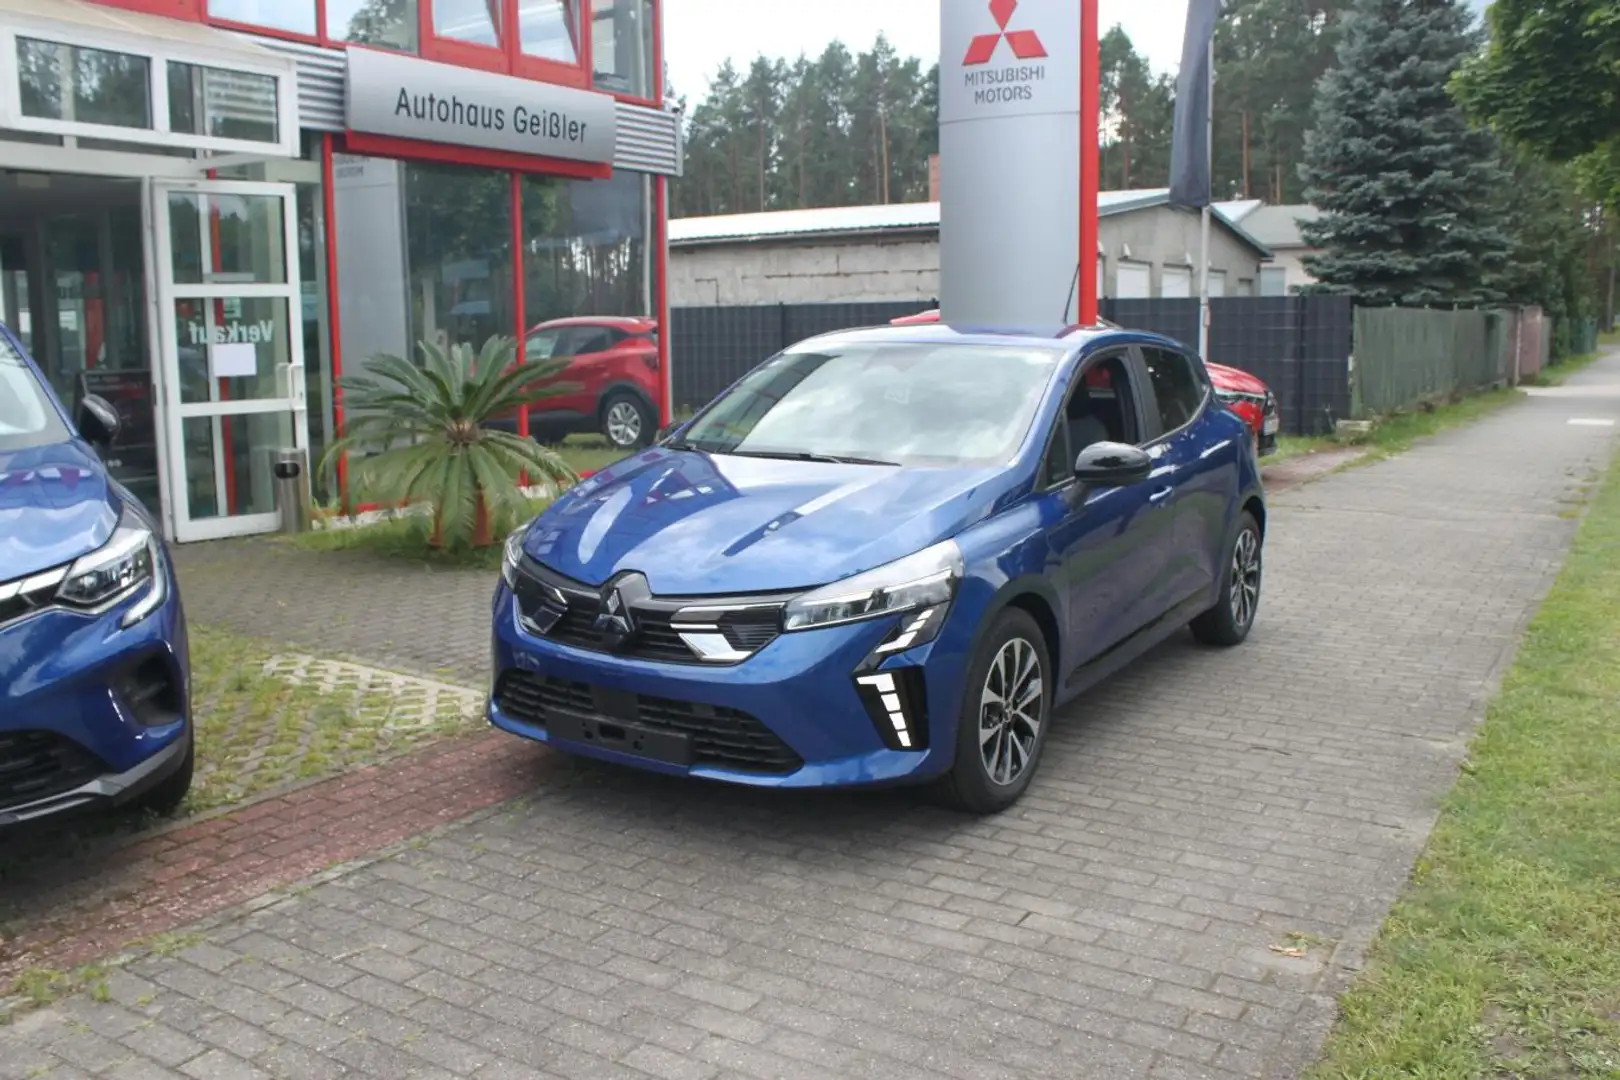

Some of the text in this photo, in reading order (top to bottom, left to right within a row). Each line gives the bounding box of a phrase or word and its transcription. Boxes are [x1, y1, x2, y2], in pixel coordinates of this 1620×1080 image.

[964, 65, 1045, 86] MITSUBISHI
[975, 85, 1032, 104] MOTORS
[394, 86, 588, 143] Autohaus Geißler
